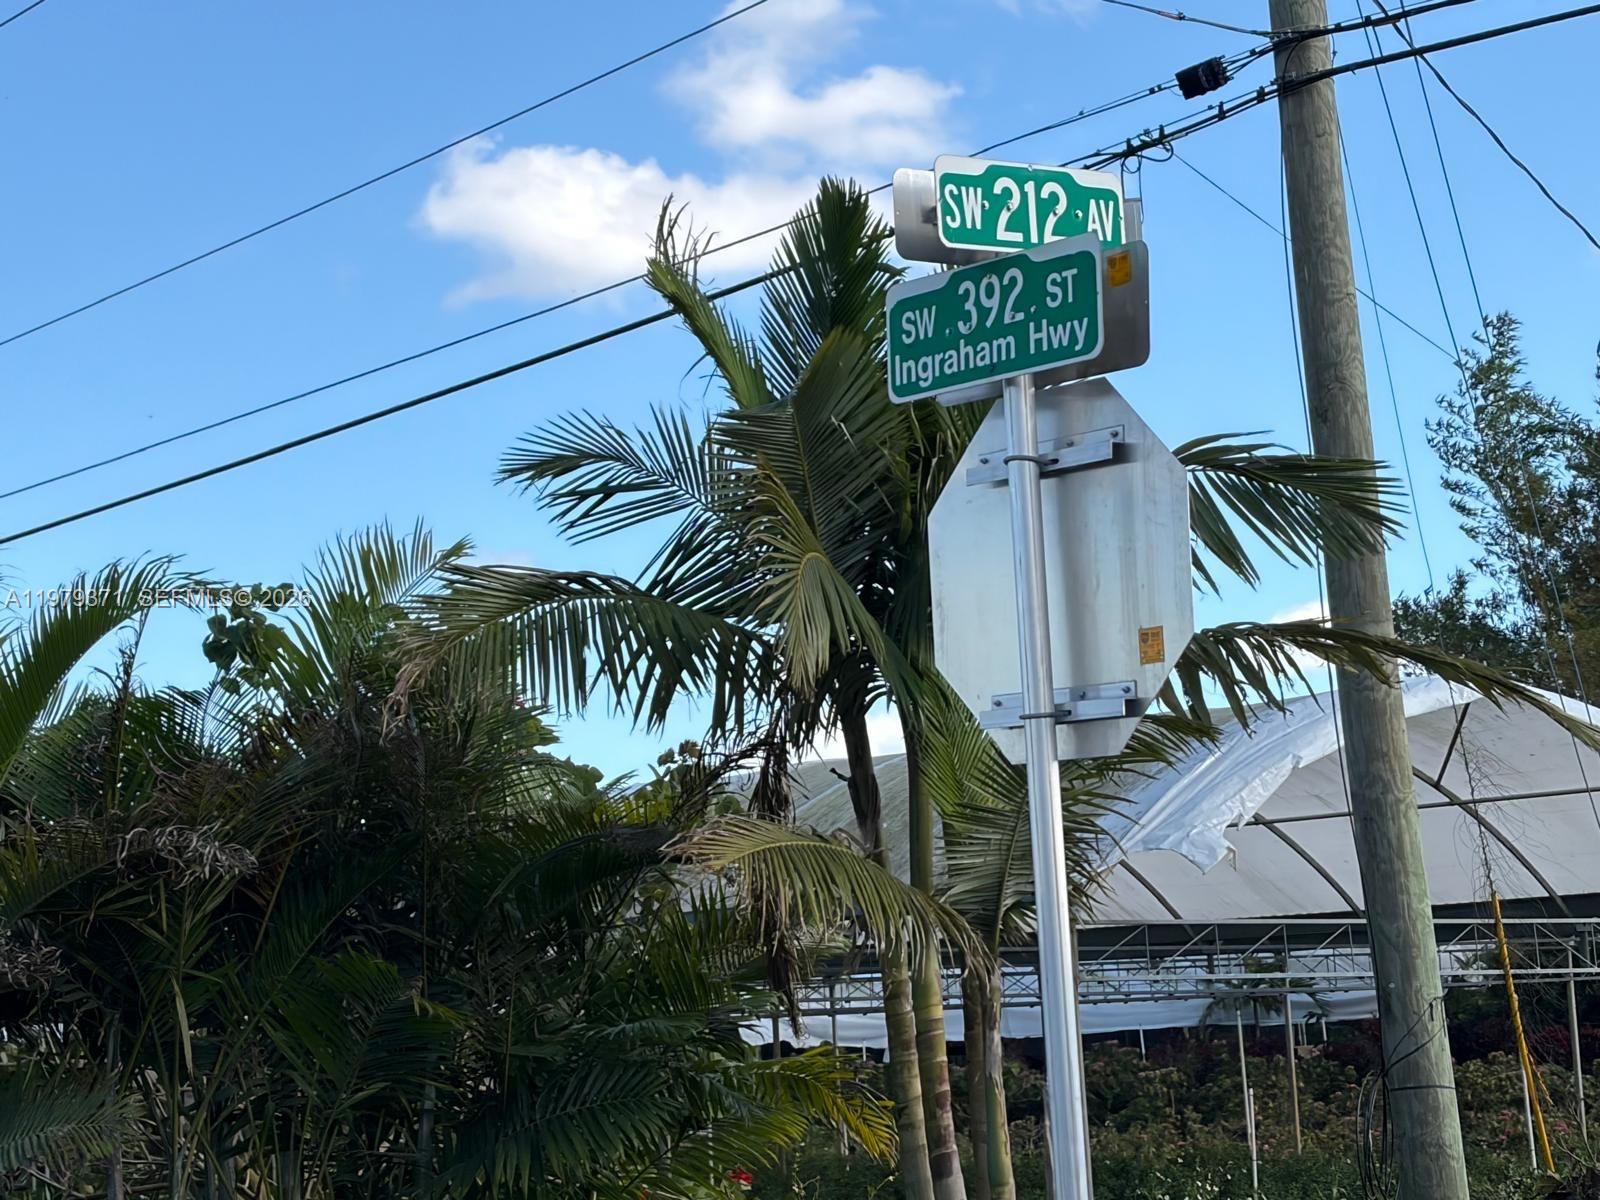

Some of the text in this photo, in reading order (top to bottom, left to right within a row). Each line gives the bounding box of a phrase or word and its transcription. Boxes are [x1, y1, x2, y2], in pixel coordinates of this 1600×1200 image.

[944, 177, 1114, 244] SW 212 AV
[901, 306, 936, 344] SW
[957, 268, 1025, 334] 392
[1046, 268, 1078, 308] ST
[895, 317, 1088, 387] Ingraham Hwy
